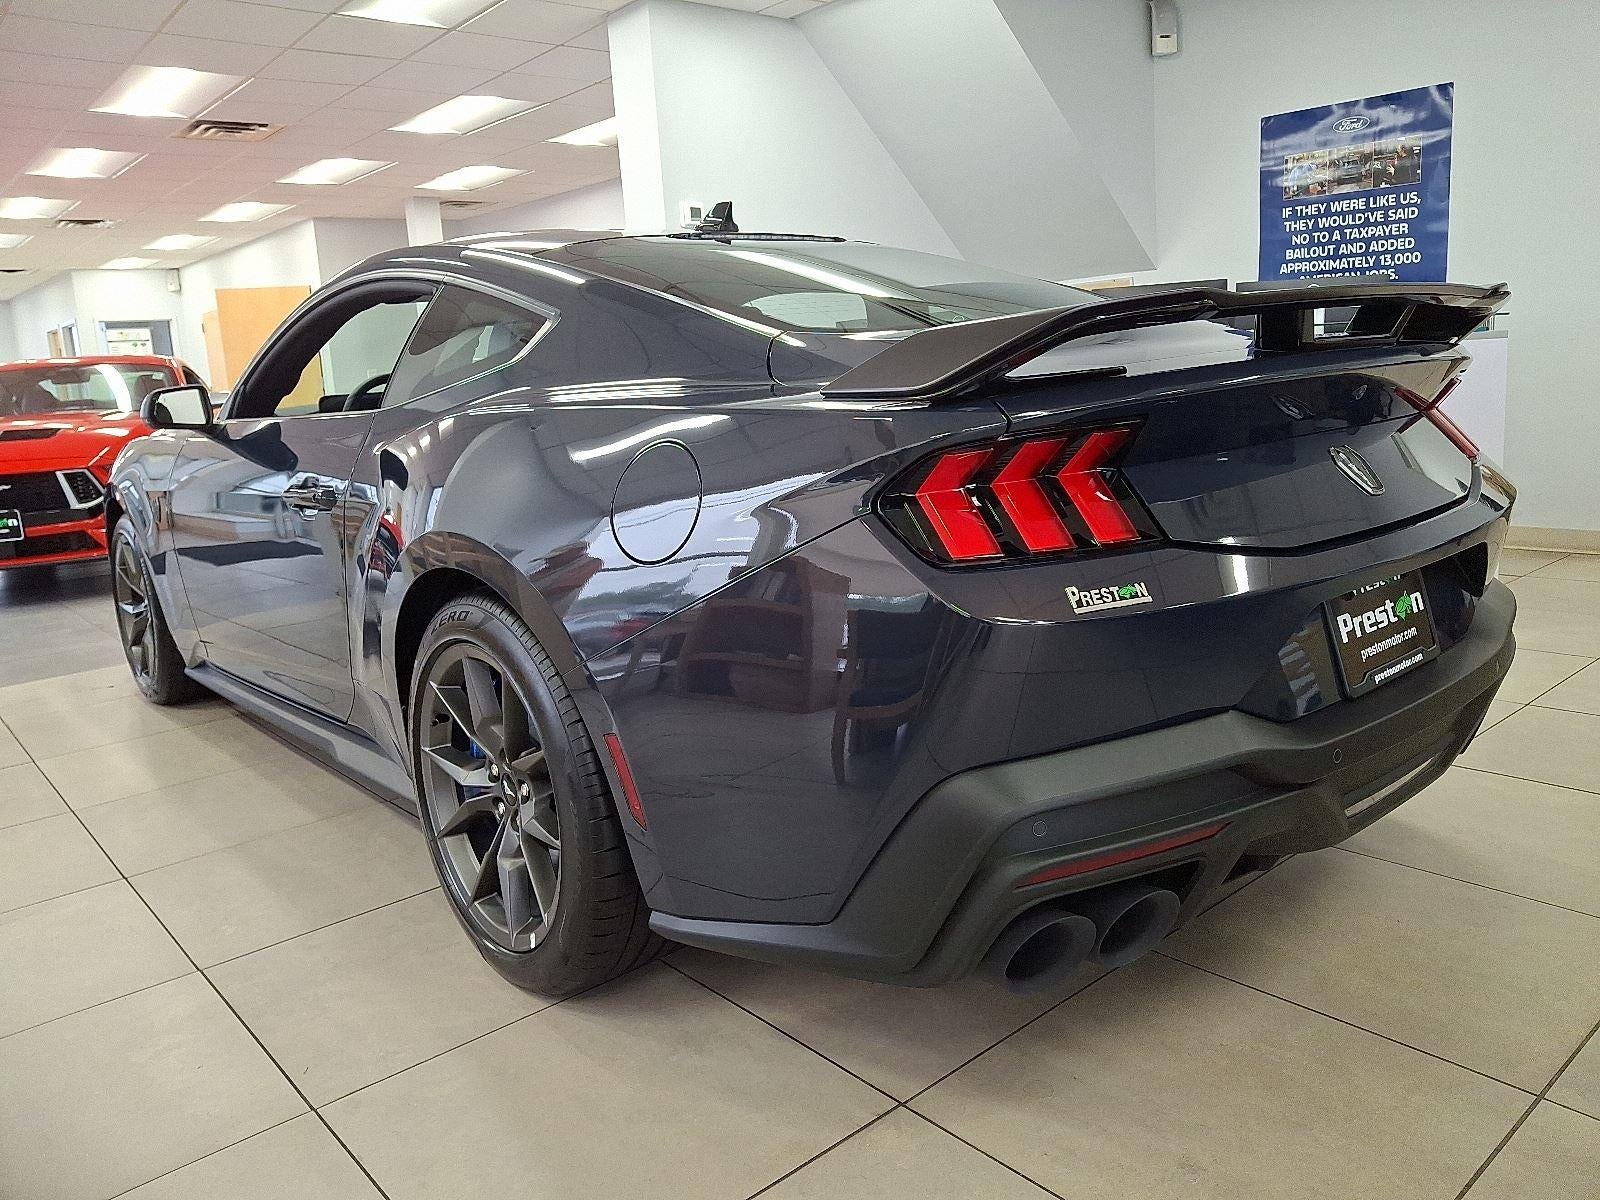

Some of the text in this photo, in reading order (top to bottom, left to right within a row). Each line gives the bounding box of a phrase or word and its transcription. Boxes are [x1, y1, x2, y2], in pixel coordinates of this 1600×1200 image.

[1338, 118, 1365, 131] Ford
[1282, 191, 1422, 219] IF THEY WERE LIKE US,
[1284, 206, 1419, 233] THEY WOULD'VE SAID
[1291, 222, 1409, 246] NO TO A TAXPAYER
[1285, 237, 1416, 261] BAILOUT AND ADDED
[1279, 255, 1377, 275] APPROXIMATELY
[1378, 251, 1422, 267] 13,000
[1360, 626, 1418, 663] prestonmotor.com
